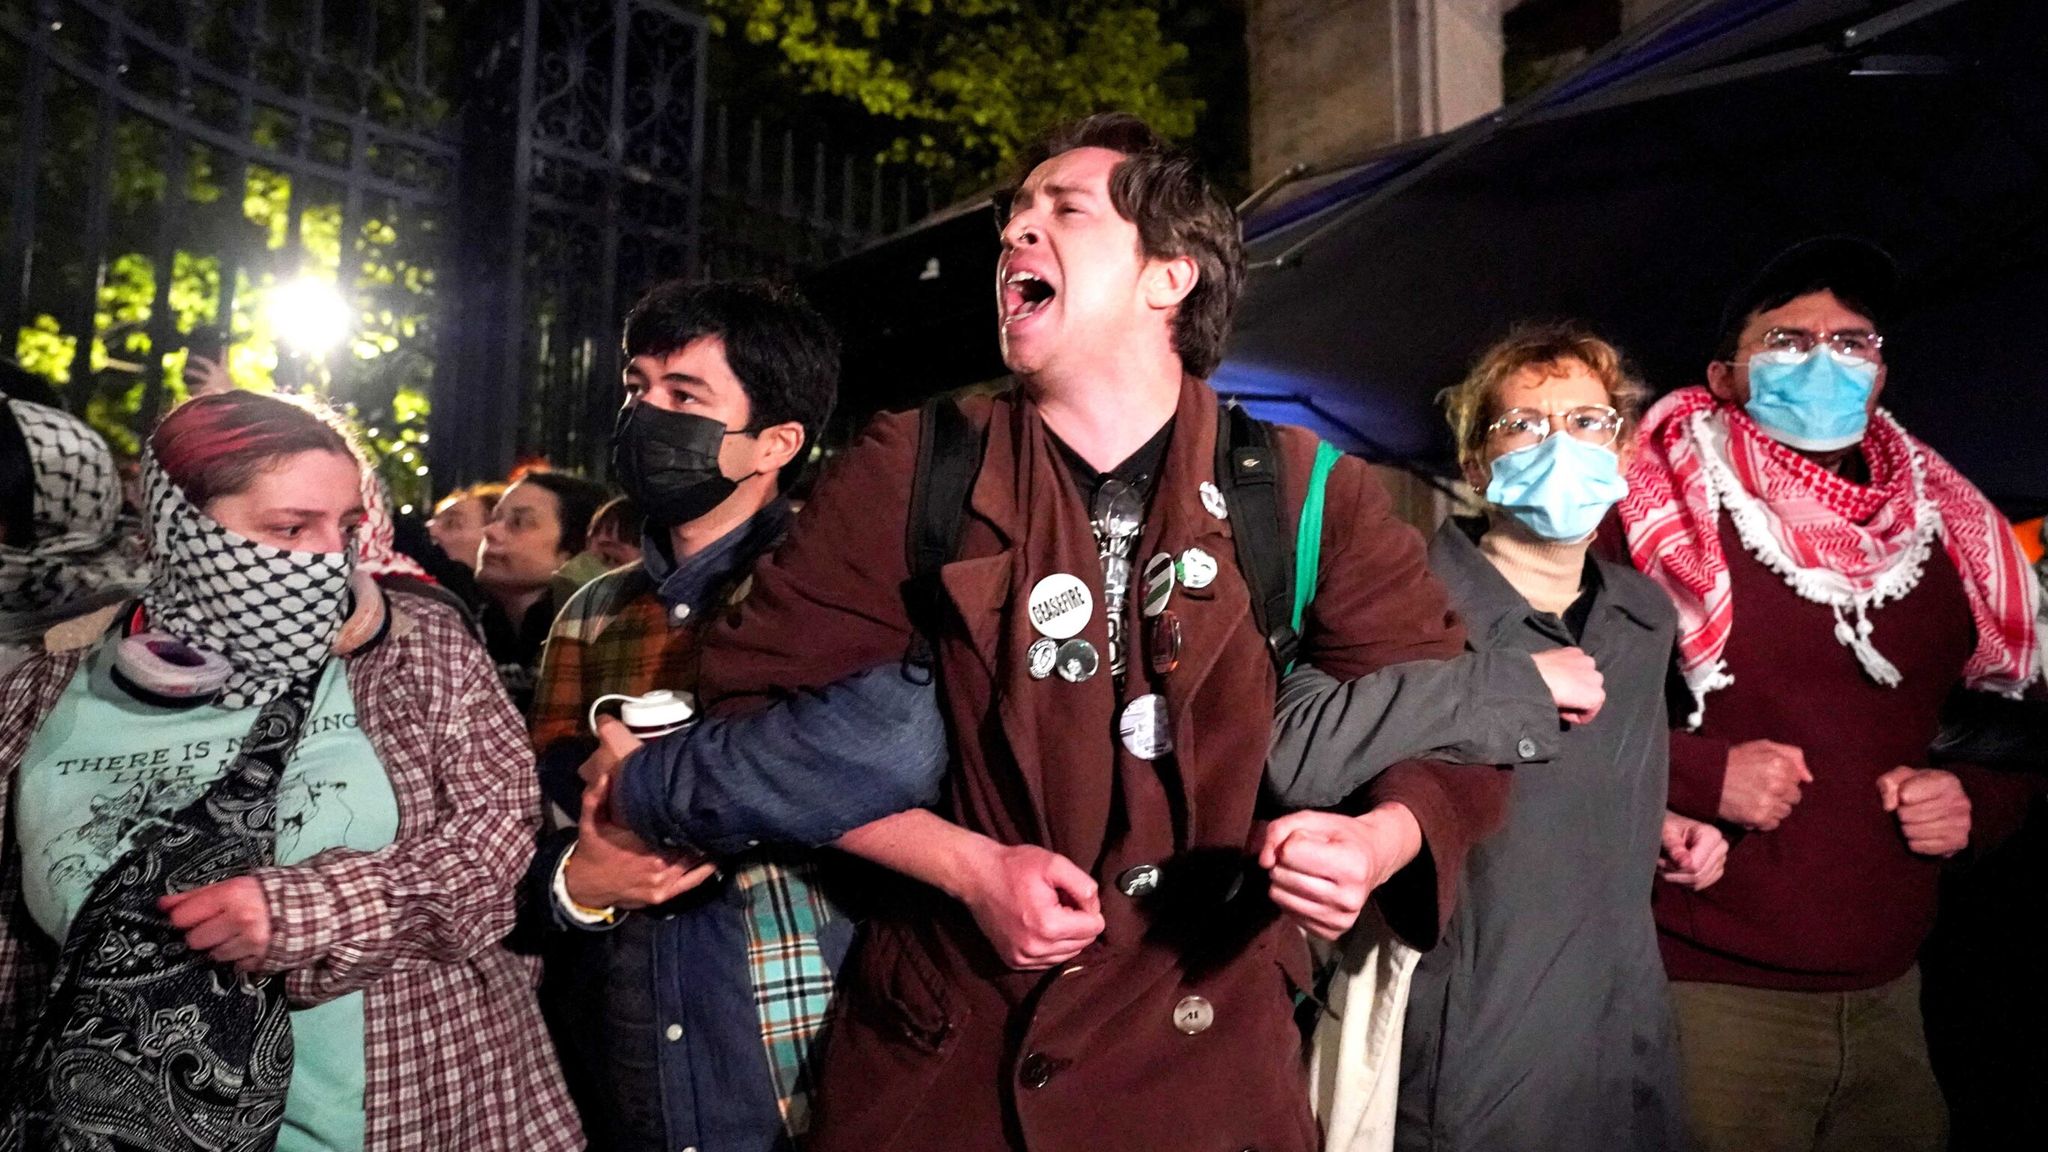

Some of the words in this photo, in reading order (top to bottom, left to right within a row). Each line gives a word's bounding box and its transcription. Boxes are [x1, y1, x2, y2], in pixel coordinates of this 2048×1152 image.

[1032, 585, 1086, 625] CEASEFIRE
[56, 748, 170, 776] THERE
[182, 741, 210, 762] IS
[226, 713, 358, 753] NING
[110, 764, 194, 784] LIKE
